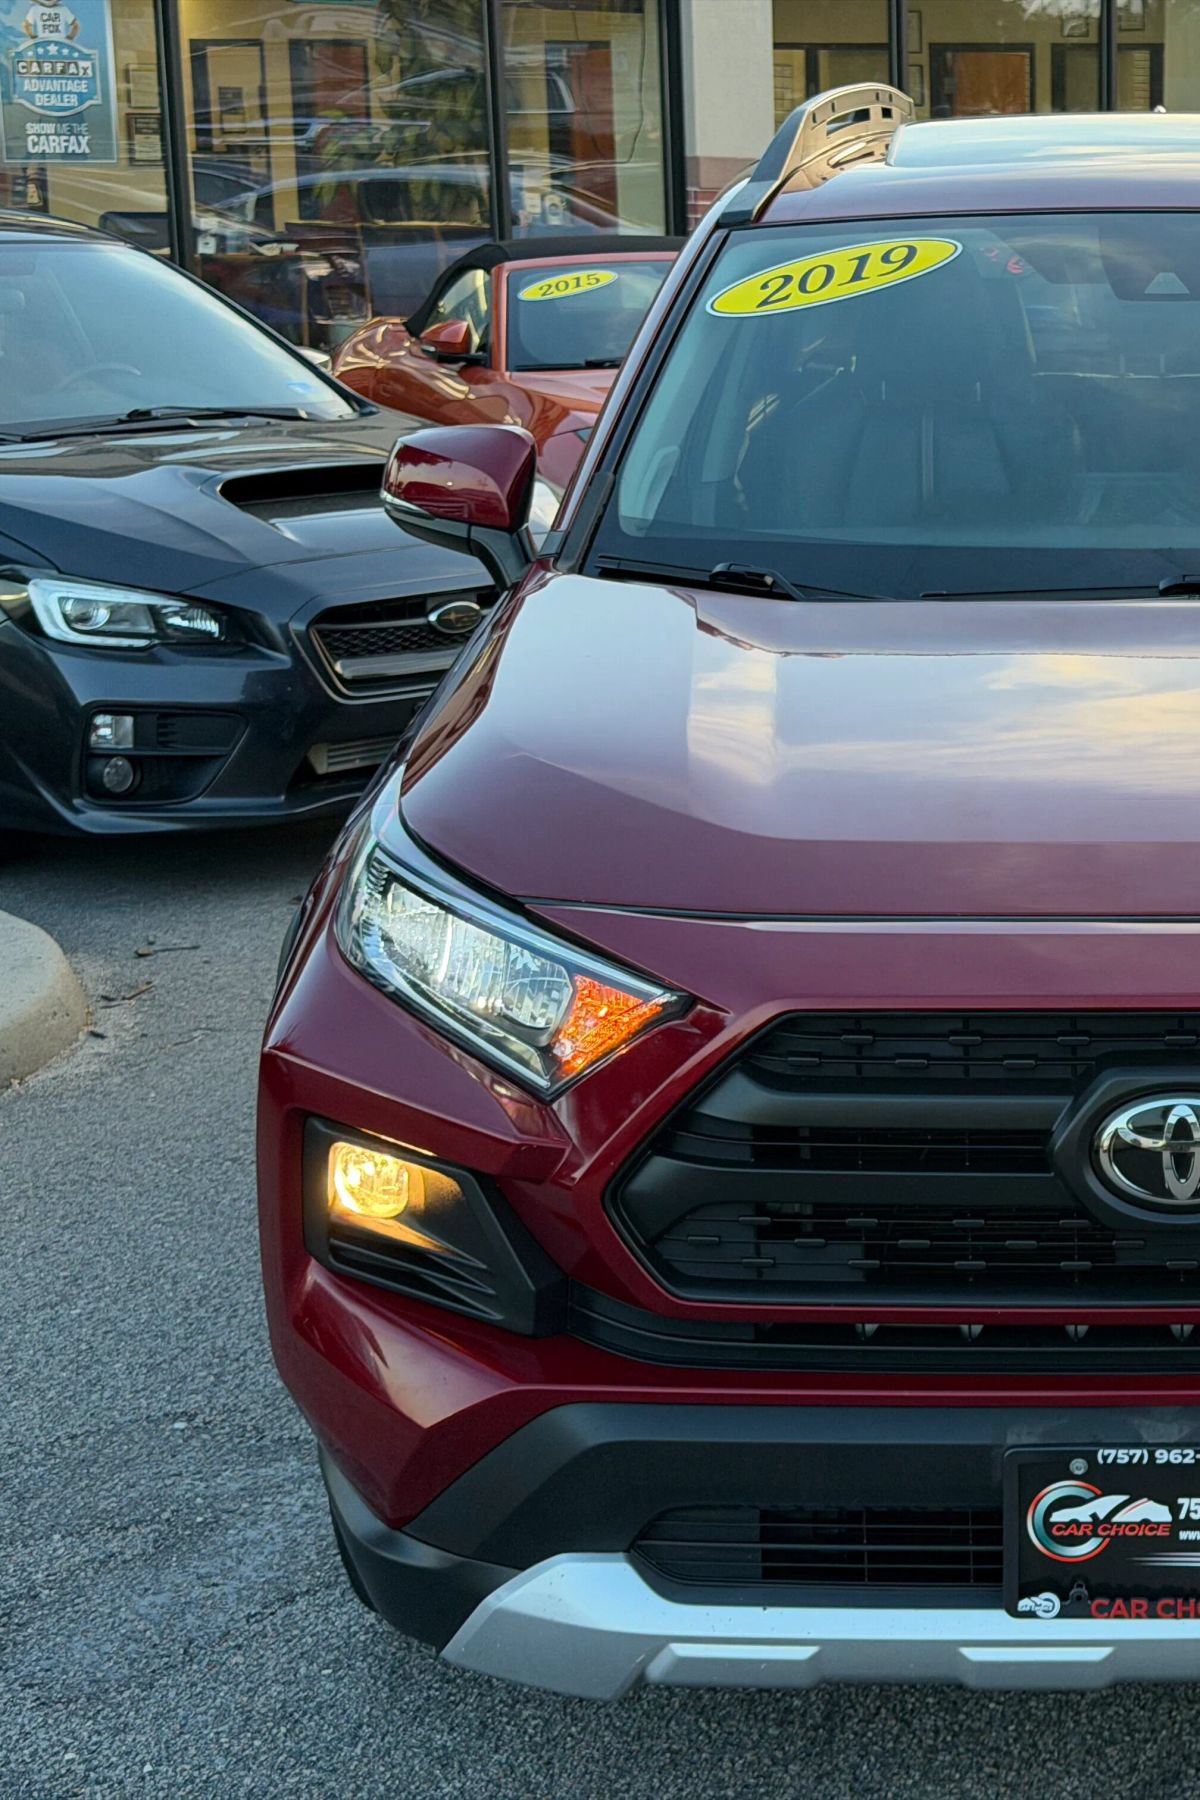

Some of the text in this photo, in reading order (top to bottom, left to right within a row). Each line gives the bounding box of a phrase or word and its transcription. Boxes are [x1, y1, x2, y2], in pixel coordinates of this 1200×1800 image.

[41, 12, 60, 22] CAR
[42, 24, 61, 33] FOX
[18, 61, 91, 76] CARFAX
[24, 79, 88, 92] ADVANTAGE
[35, 94, 78, 106] DEALER
[26, 122, 55, 135] SHOW
[27, 135, 90, 154] CARFAX
[755, 244, 918, 309] 2019
[538, 273, 600, 297] 2015
[1097, 1448, 1149, 1465] (757)
[1051, 1523, 1172, 1537] CAR CHOICE
[1090, 1598, 1148, 1619] CAR
